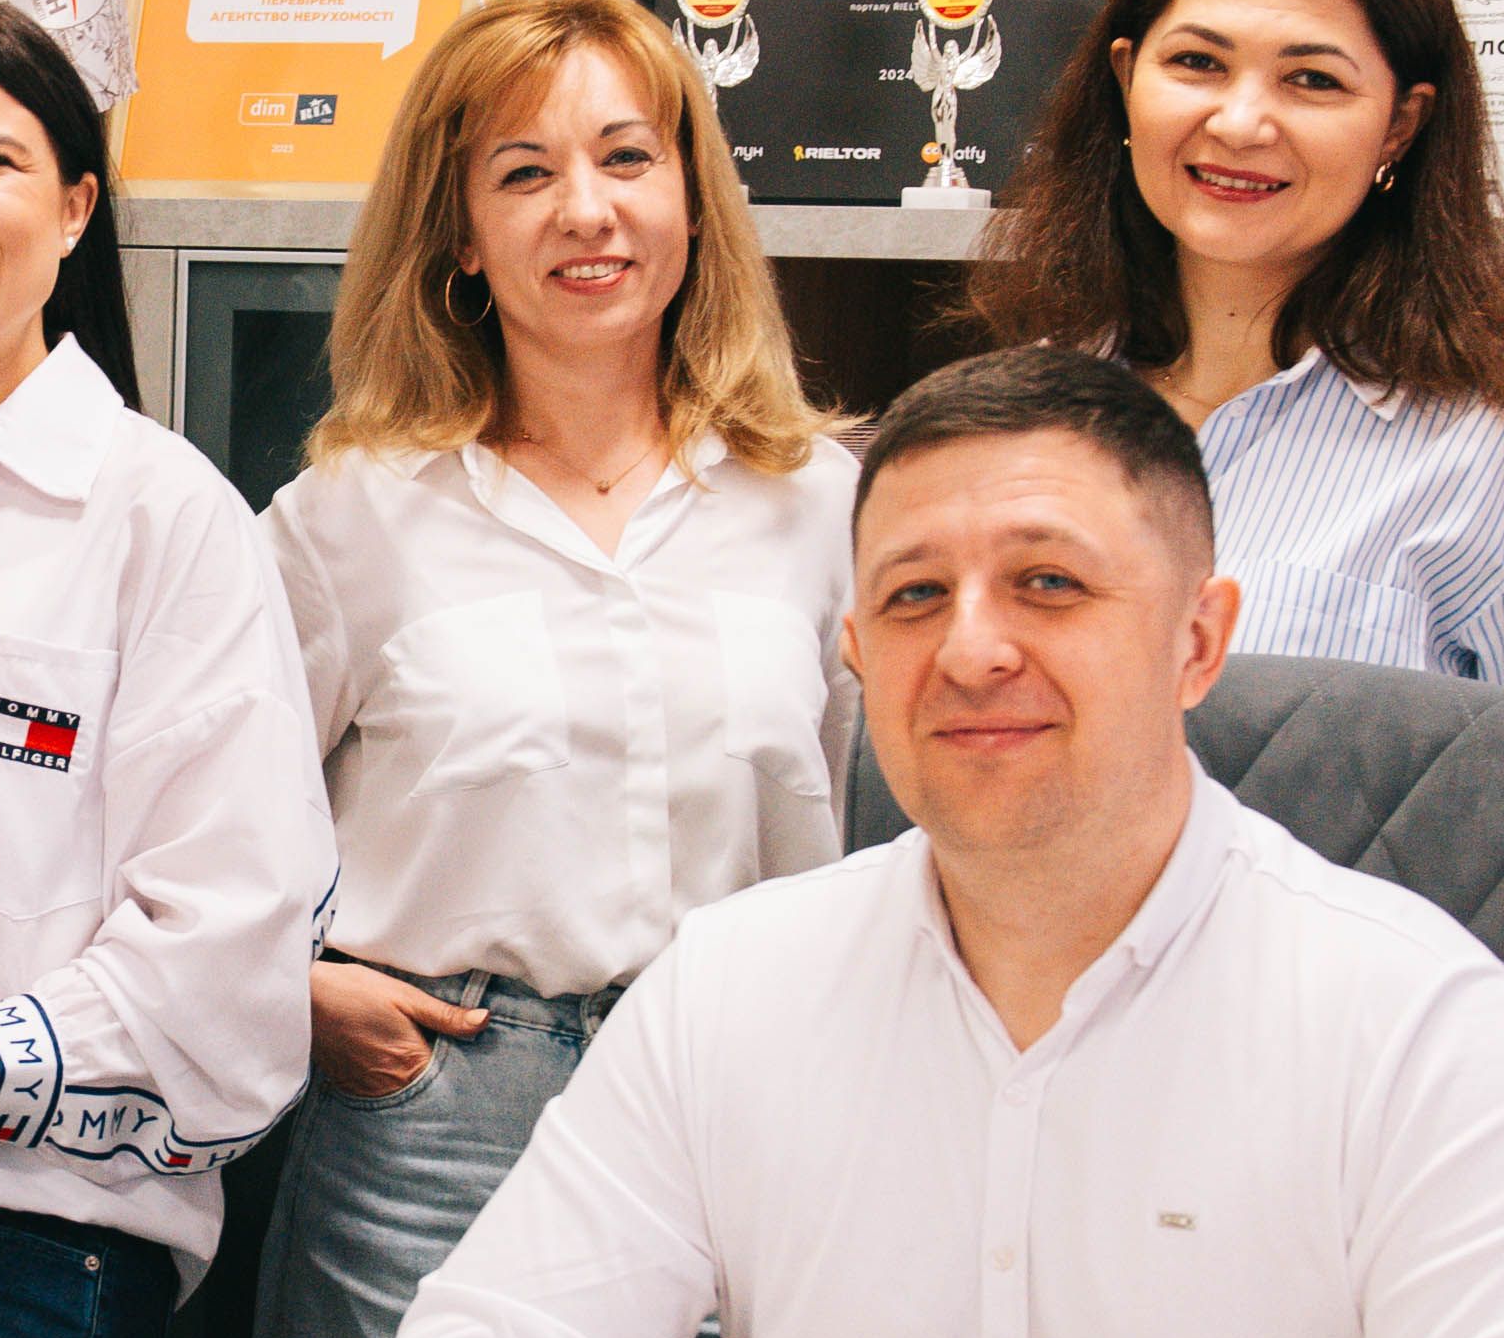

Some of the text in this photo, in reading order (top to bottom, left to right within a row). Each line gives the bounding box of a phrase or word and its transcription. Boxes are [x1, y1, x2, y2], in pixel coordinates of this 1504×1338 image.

[850, 2, 922, 13] порталу RIELT
[210, 11, 394, 22] АГЕНТСТВО НЕРУХОМОСТІ
[878, 68, 914, 81] 2024
[250, 99, 333, 121] dim RIA
[805, 146, 881, 160] RIELTOR
[953, 146, 986, 164] atfy
[52, 1106, 158, 1140] MMY
